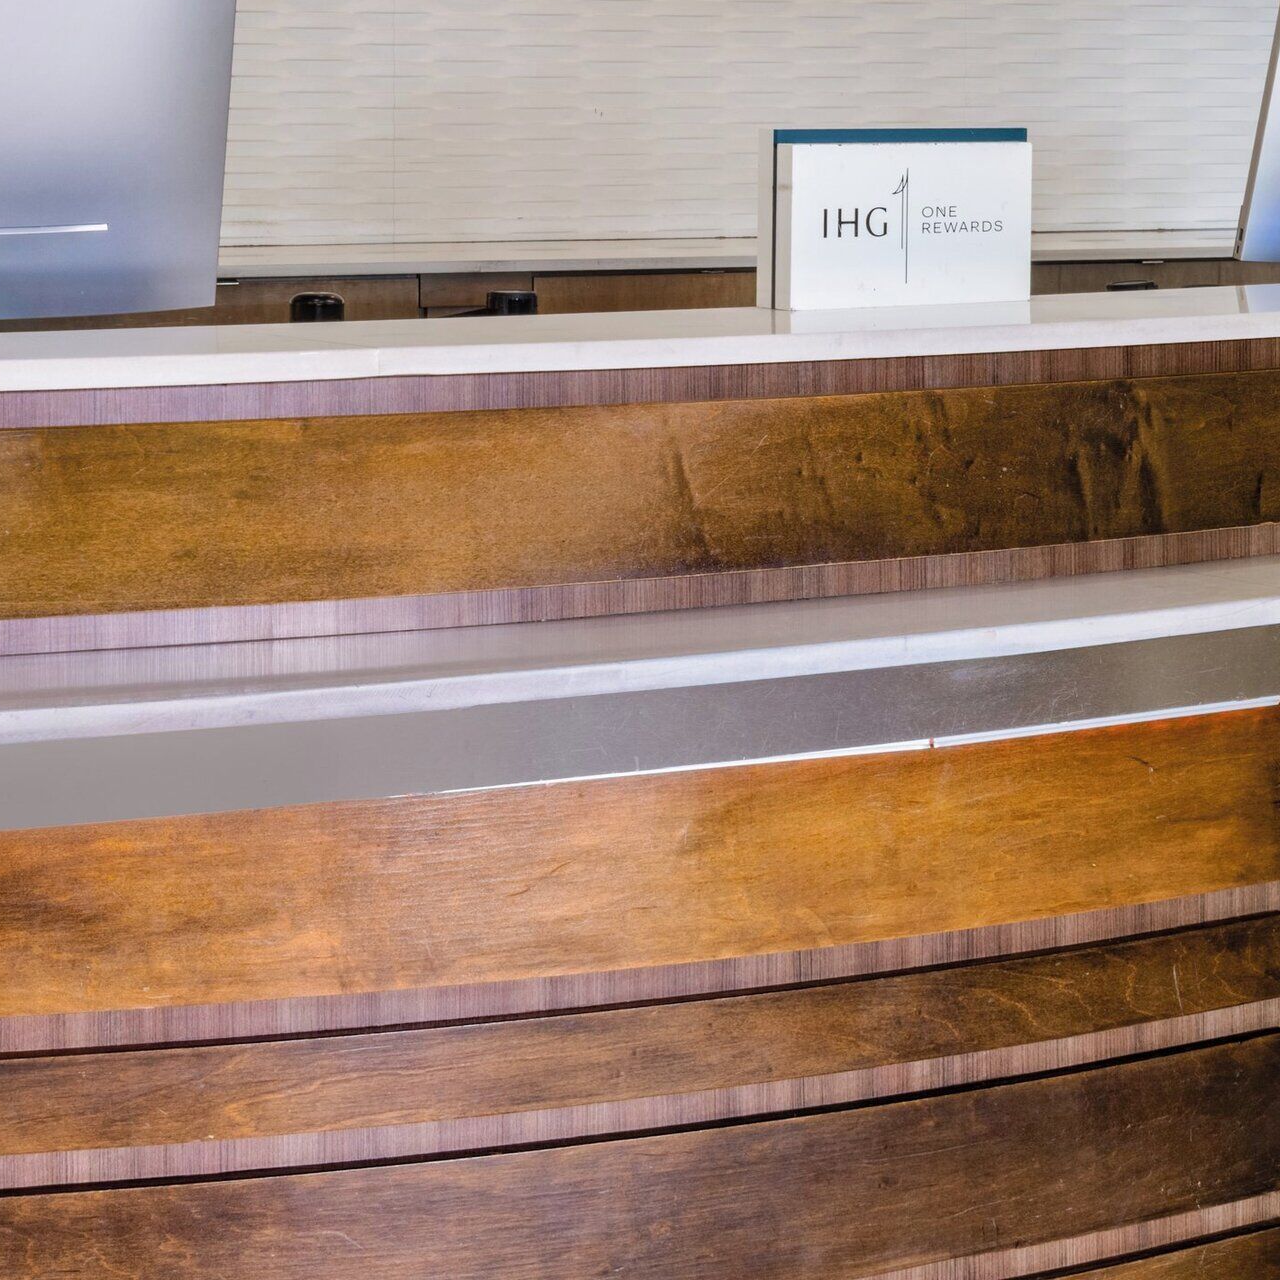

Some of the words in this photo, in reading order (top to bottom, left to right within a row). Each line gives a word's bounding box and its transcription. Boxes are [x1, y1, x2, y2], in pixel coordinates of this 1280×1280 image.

[823, 206, 888, 238] IHG
[921, 206, 957, 218] ONE
[921, 220, 1003, 234] REWARDS
